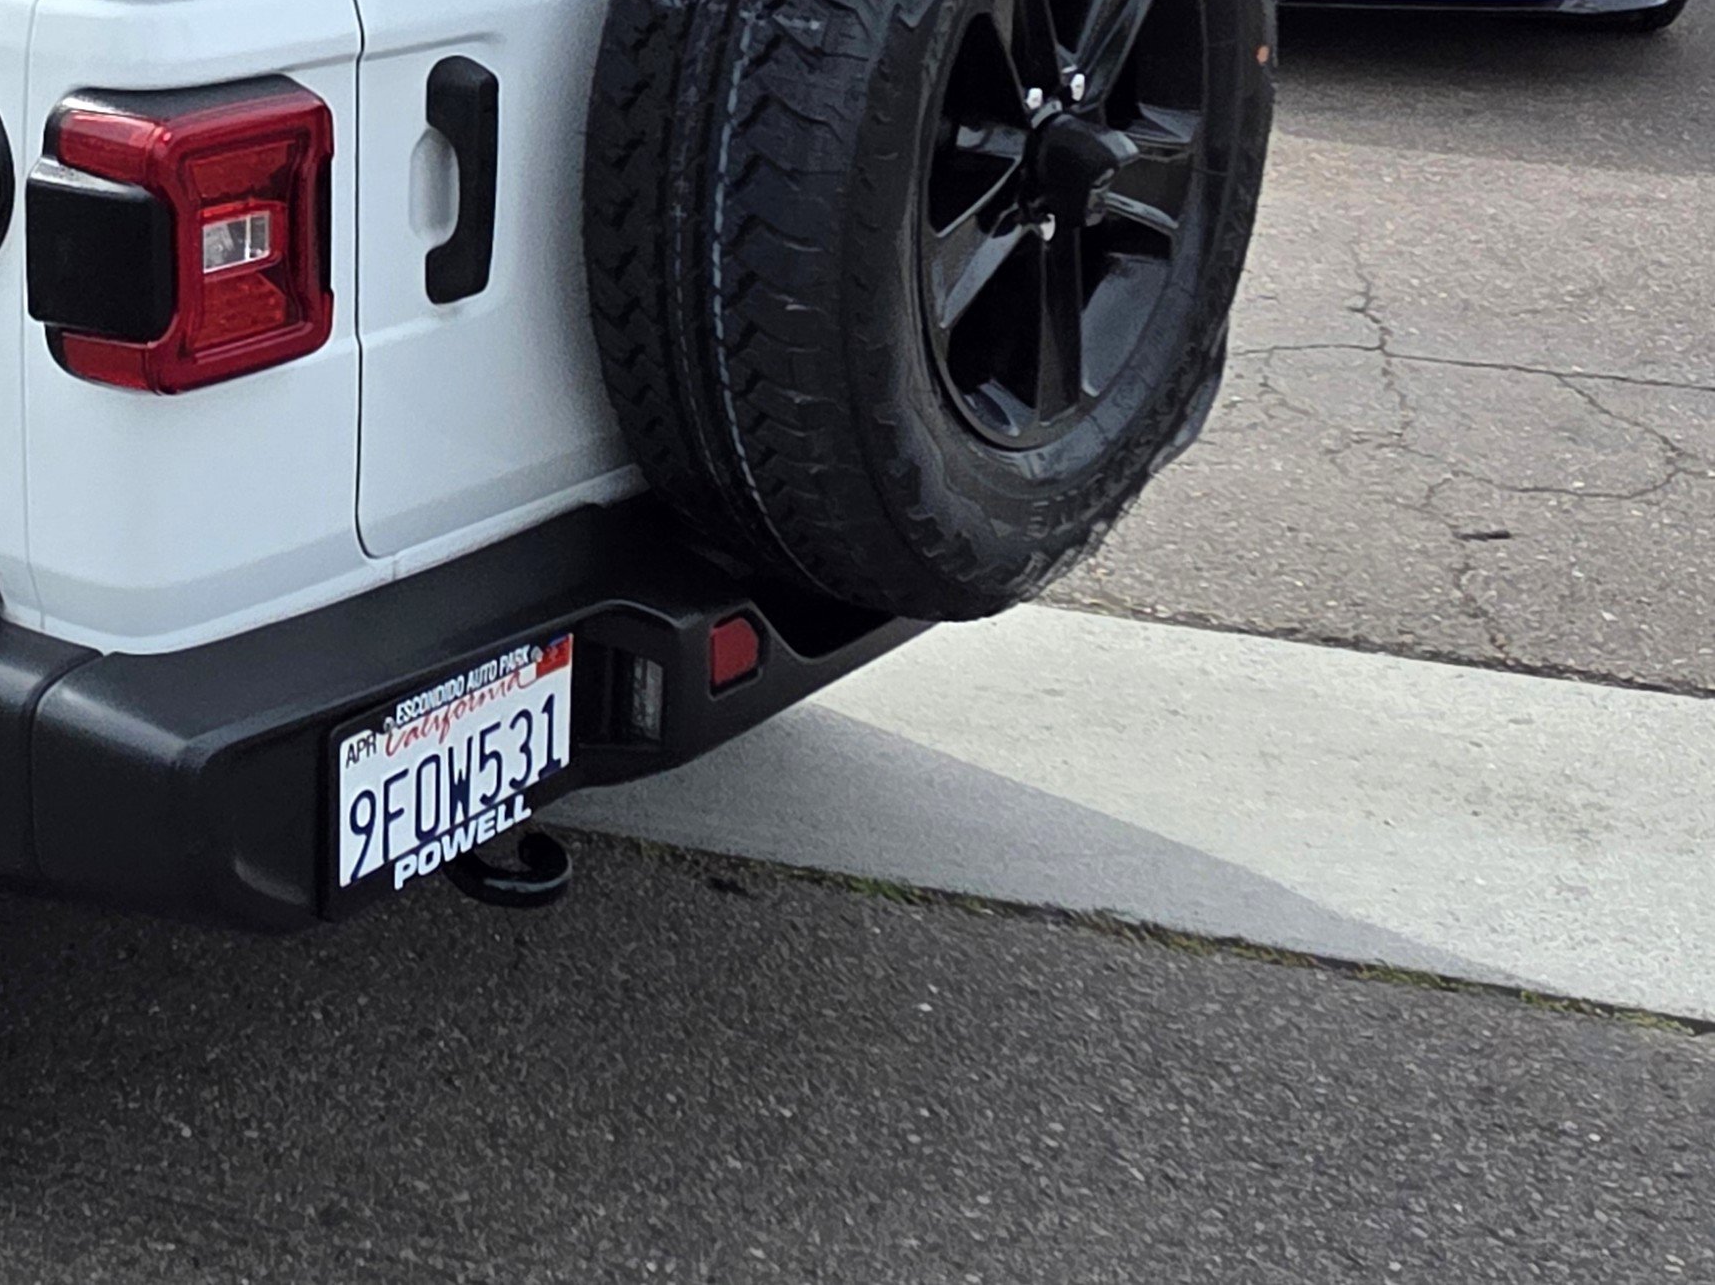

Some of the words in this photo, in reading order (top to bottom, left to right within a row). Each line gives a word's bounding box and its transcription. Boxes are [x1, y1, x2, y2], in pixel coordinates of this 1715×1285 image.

[385, 667, 537, 757] California
[395, 674, 465, 724] ESCONDIDO
[466, 659, 498, 696] AUTO
[499, 645, 531, 676] PARK
[346, 729, 377, 769] APR
[394, 794, 532, 890] POWELL
